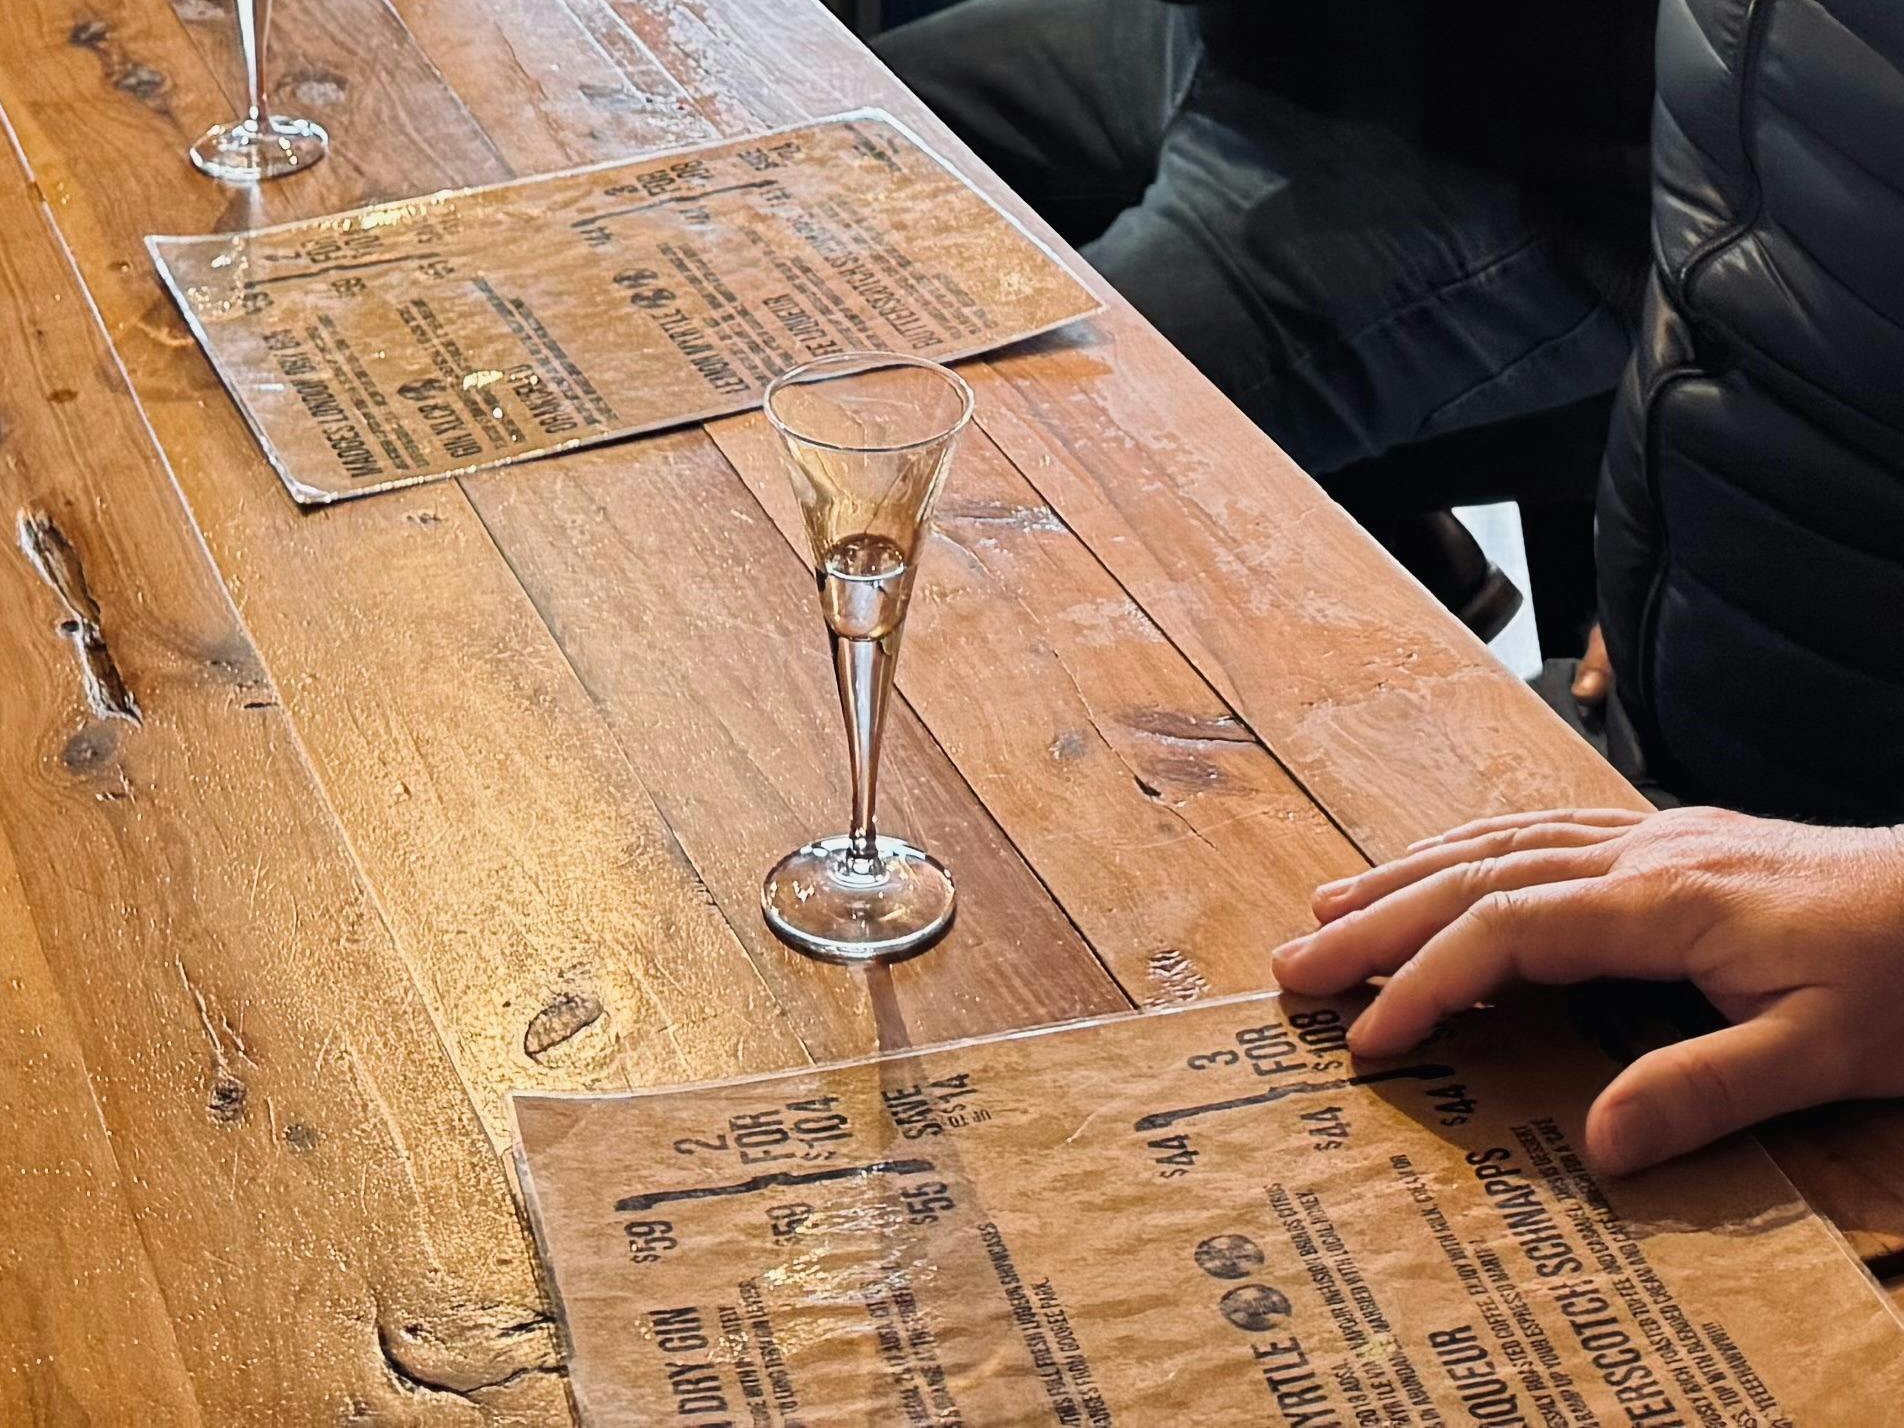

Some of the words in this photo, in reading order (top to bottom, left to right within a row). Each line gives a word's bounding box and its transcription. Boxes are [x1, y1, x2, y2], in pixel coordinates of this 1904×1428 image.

[1187, 1050, 1238, 1068] 3
[1236, 1023, 1307, 1075] FOR
[1290, 1011, 1348, 1071] $108
[881, 1084, 943, 1139] SAVE
[927, 1073, 978, 1114] $14
[1424, 1084, 1477, 1124] $44
[675, 1134, 727, 1152] 2
[729, 1110, 793, 1163] FOR
[788, 1097, 851, 1159] $104
[1299, 1108, 1349, 1150] $44
[1509, 1126, 1552, 1165] DESSERT
[1147, 1135, 1198, 1176] $44
[1388, 1152, 1411, 1170] OR
[901, 1181, 954, 1222] $55
[1263, 1181, 1297, 1217] CITRUS
[1464, 1148, 1584, 1278] SCHNAPPS
[622, 1221, 678, 1263] $59
[976, 1223, 1020, 1285] SHOWCASES
[1282, 1217, 1318, 1257] BRINGS
[1315, 1224, 1348, 1257] LOCAL
[1436, 1233, 1467, 1262] WITH
[1617, 1242, 1646, 1267] AND
[1303, 1257, 1345, 1306] INFUSION
[1331, 1257, 1363, 1285] WITH
[1452, 1261, 1488, 1295] ENJOY
[1594, 1254, 1623, 1276] AND
[1633, 1263, 1673, 1304] CREAM
[1349, 1284, 1391, 1333] MARRIED
[1495, 1283, 1545, 1338] ESPRESSO
[1612, 1278, 1650, 1316] TOFFEE
[647, 1307, 708, 1350] GIN
[1330, 1305, 1369, 1350] VAPOUR
[1637, 1316, 1682, 1364] TOASTED
[1658, 1304, 1706, 1354] BLENDED
[1025, 1332, 1056, 1368] FRESH
[1500, 1339, 1548, 1393] ROASTED
[1530, 1338, 1561, 1369] YOUR
[1693, 1354, 1727, 1383] WITH
[665, 1359, 728, 1414] DRY
[1427, 1324, 1528, 1428] IQUEUR
[1548, 1368, 1573, 1387] UP
[1669, 1366, 1702, 1394] RICH
[1712, 1385, 1742, 1407] TOP
